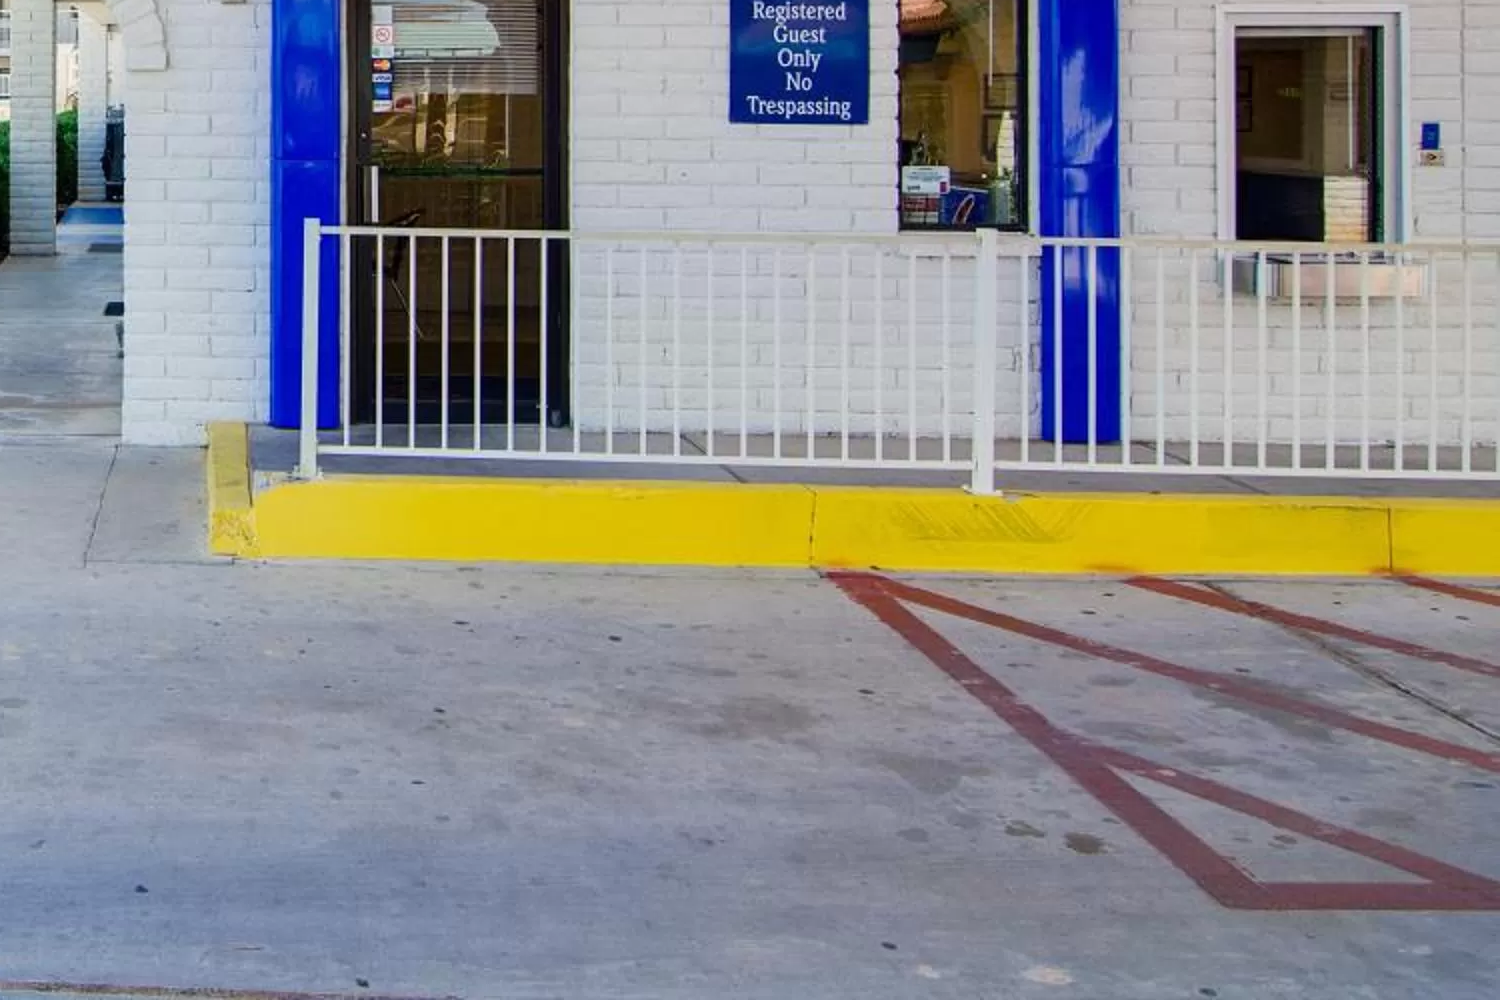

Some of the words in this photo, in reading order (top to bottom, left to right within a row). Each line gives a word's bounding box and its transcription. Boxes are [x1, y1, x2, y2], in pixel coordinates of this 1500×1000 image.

[752, 1, 846, 24] Registered
[773, 25, 827, 43] Guest
[777, 48, 821, 72] Only
[786, 72, 813, 91] No
[746, 96, 852, 120] Trespassing
